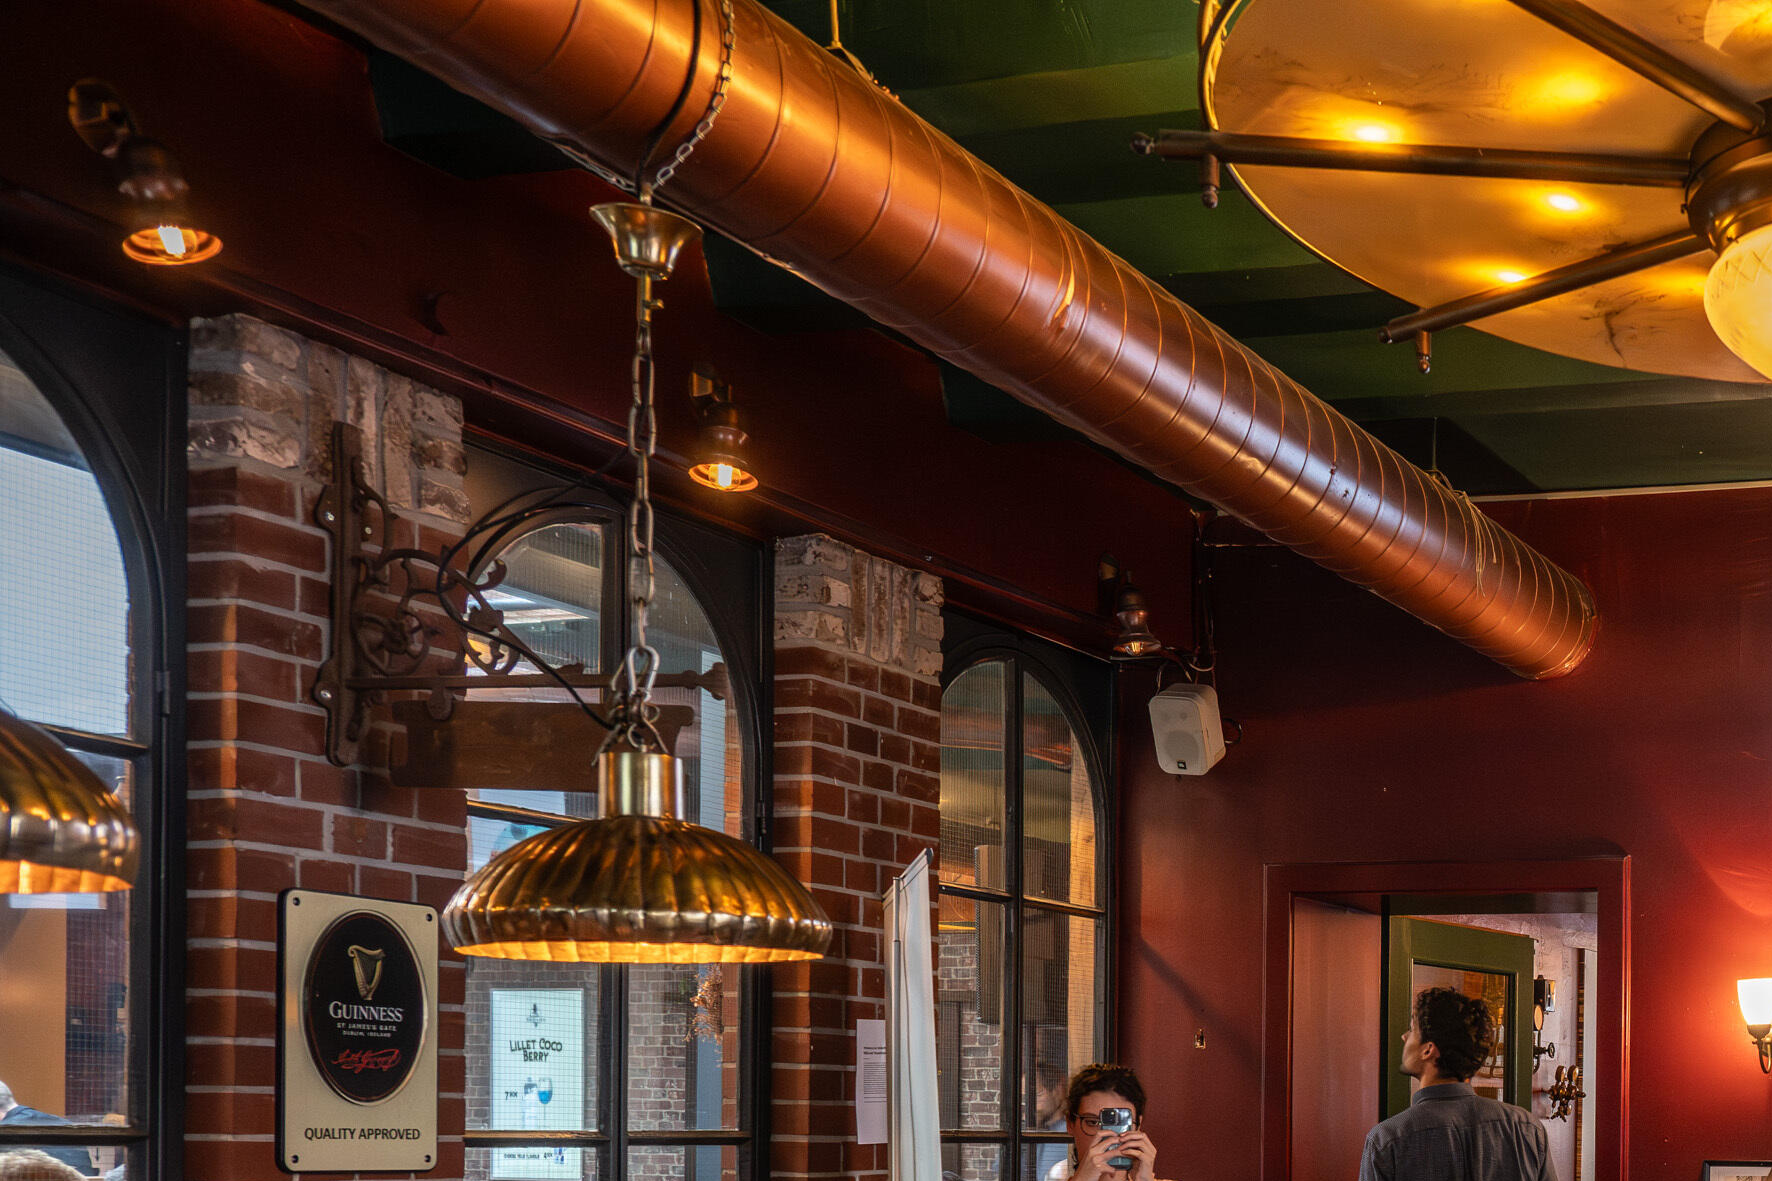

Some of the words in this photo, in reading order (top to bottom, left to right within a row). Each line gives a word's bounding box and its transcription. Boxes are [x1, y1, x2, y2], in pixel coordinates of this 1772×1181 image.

[329, 1001, 403, 1022] GUINNESS
[509, 1040, 537, 1052] LILLET
[539, 1038, 563, 1052] COCO
[523, 1050, 549, 1062] BERRY
[304, 1128, 356, 1141] QUALITY
[358, 1128, 421, 1140] APPROVED
